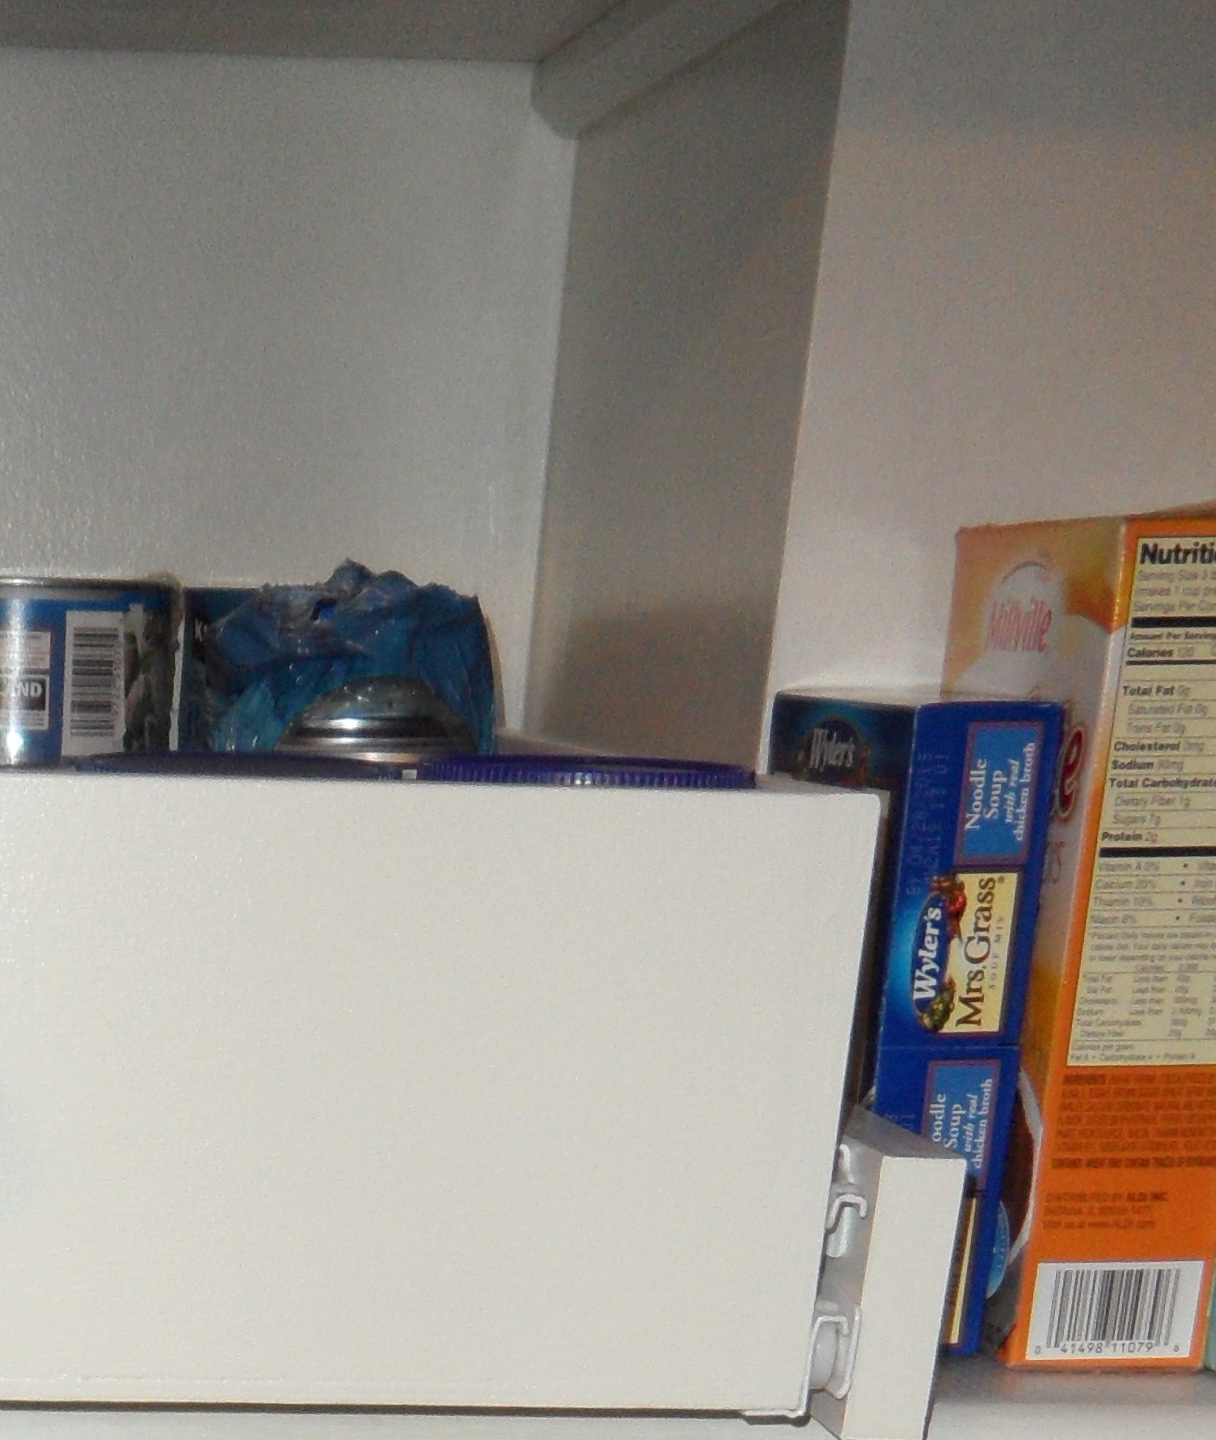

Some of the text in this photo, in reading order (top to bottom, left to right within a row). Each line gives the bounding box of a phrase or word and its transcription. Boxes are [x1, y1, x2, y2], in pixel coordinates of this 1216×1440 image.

[1140, 542, 1216, 565] Nutriti
[1128, 647, 1174, 657] Calories
[1123, 686, 1174, 696] Total Fat
[1114, 741, 1181, 752] Cholesterol
[1111, 759, 1154, 770] Sodium
[965, 758, 987, 831] Noodle
[986, 769, 1007, 819] Soup
[1005, 758, 1020, 824] with real
[1014, 742, 1036, 842] chicken broth
[1109, 778, 1139, 788] Total
[1102, 832, 1142, 841] Protein
[913, 904, 943, 1001] Wyler's
[931, 1091, 948, 1143] oodle
[945, 1102, 964, 1149] Soup
[973, 1077, 993, 1170] chicken broth
[964, 1120, 978, 1151] with
[1060, 1341, 1154, 1354] 41498 11079
